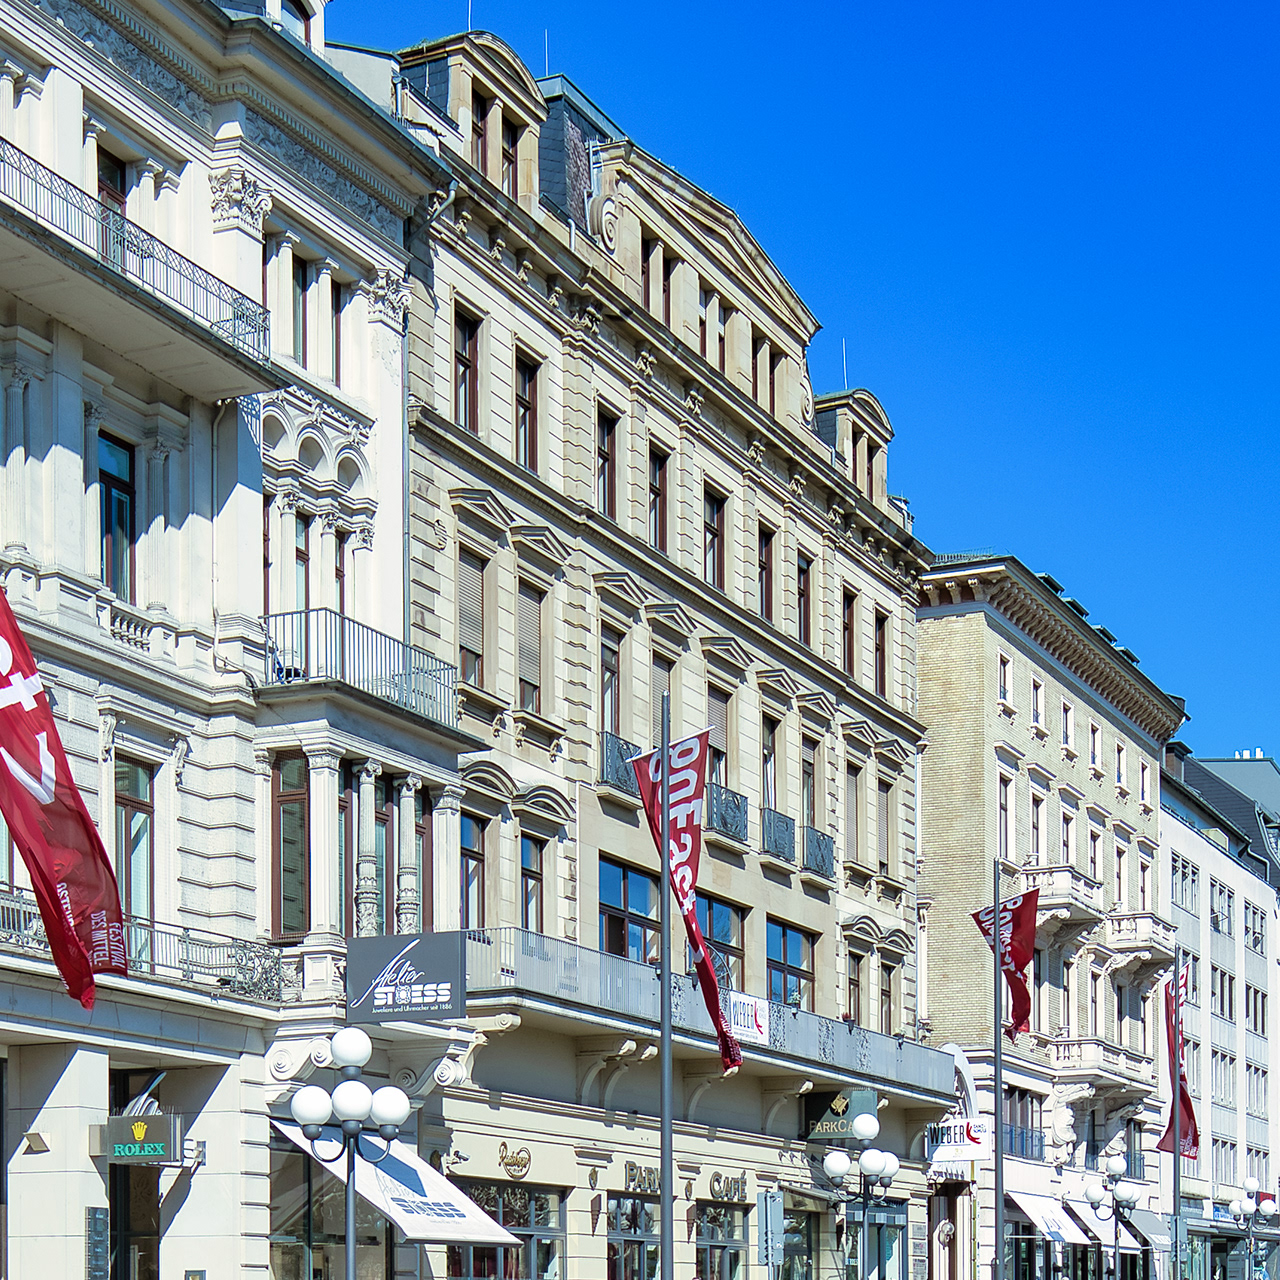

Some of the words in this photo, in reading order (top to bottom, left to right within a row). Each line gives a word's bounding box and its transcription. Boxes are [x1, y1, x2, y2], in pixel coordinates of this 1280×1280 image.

[350, 938, 425, 1008] Atelier
[394, 1005, 404, 1013] und
[404, 1003, 429, 1012] Uhrmacher
[430, 1003, 439, 1011] seit
[930, 1124, 965, 1144] WEBER
[113, 1143, 166, 1157] ROLEX
[709, 1169, 748, 1200] CAFÉ
